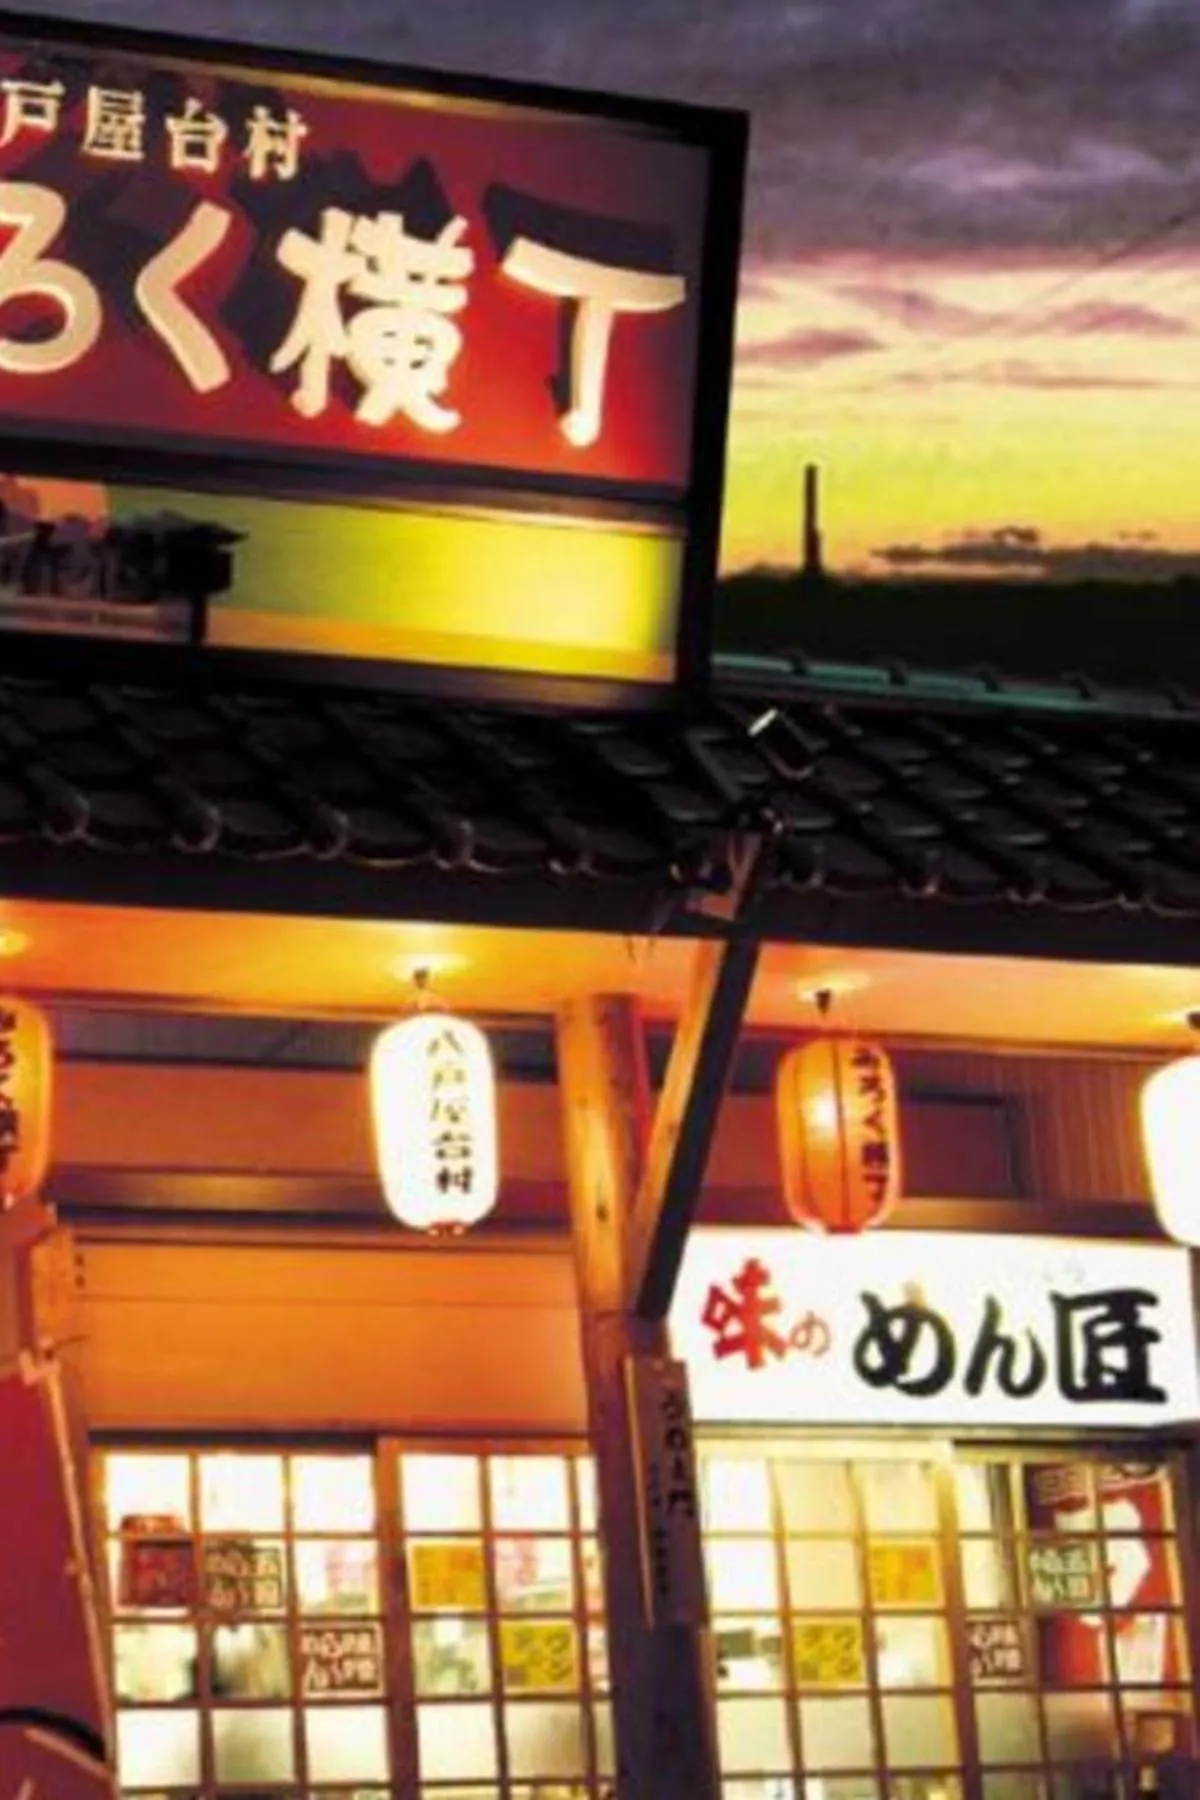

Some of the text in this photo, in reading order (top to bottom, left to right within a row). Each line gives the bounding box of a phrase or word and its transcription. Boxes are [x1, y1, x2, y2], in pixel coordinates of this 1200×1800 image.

[700, 1258, 1170, 1405] 味の めん匠
